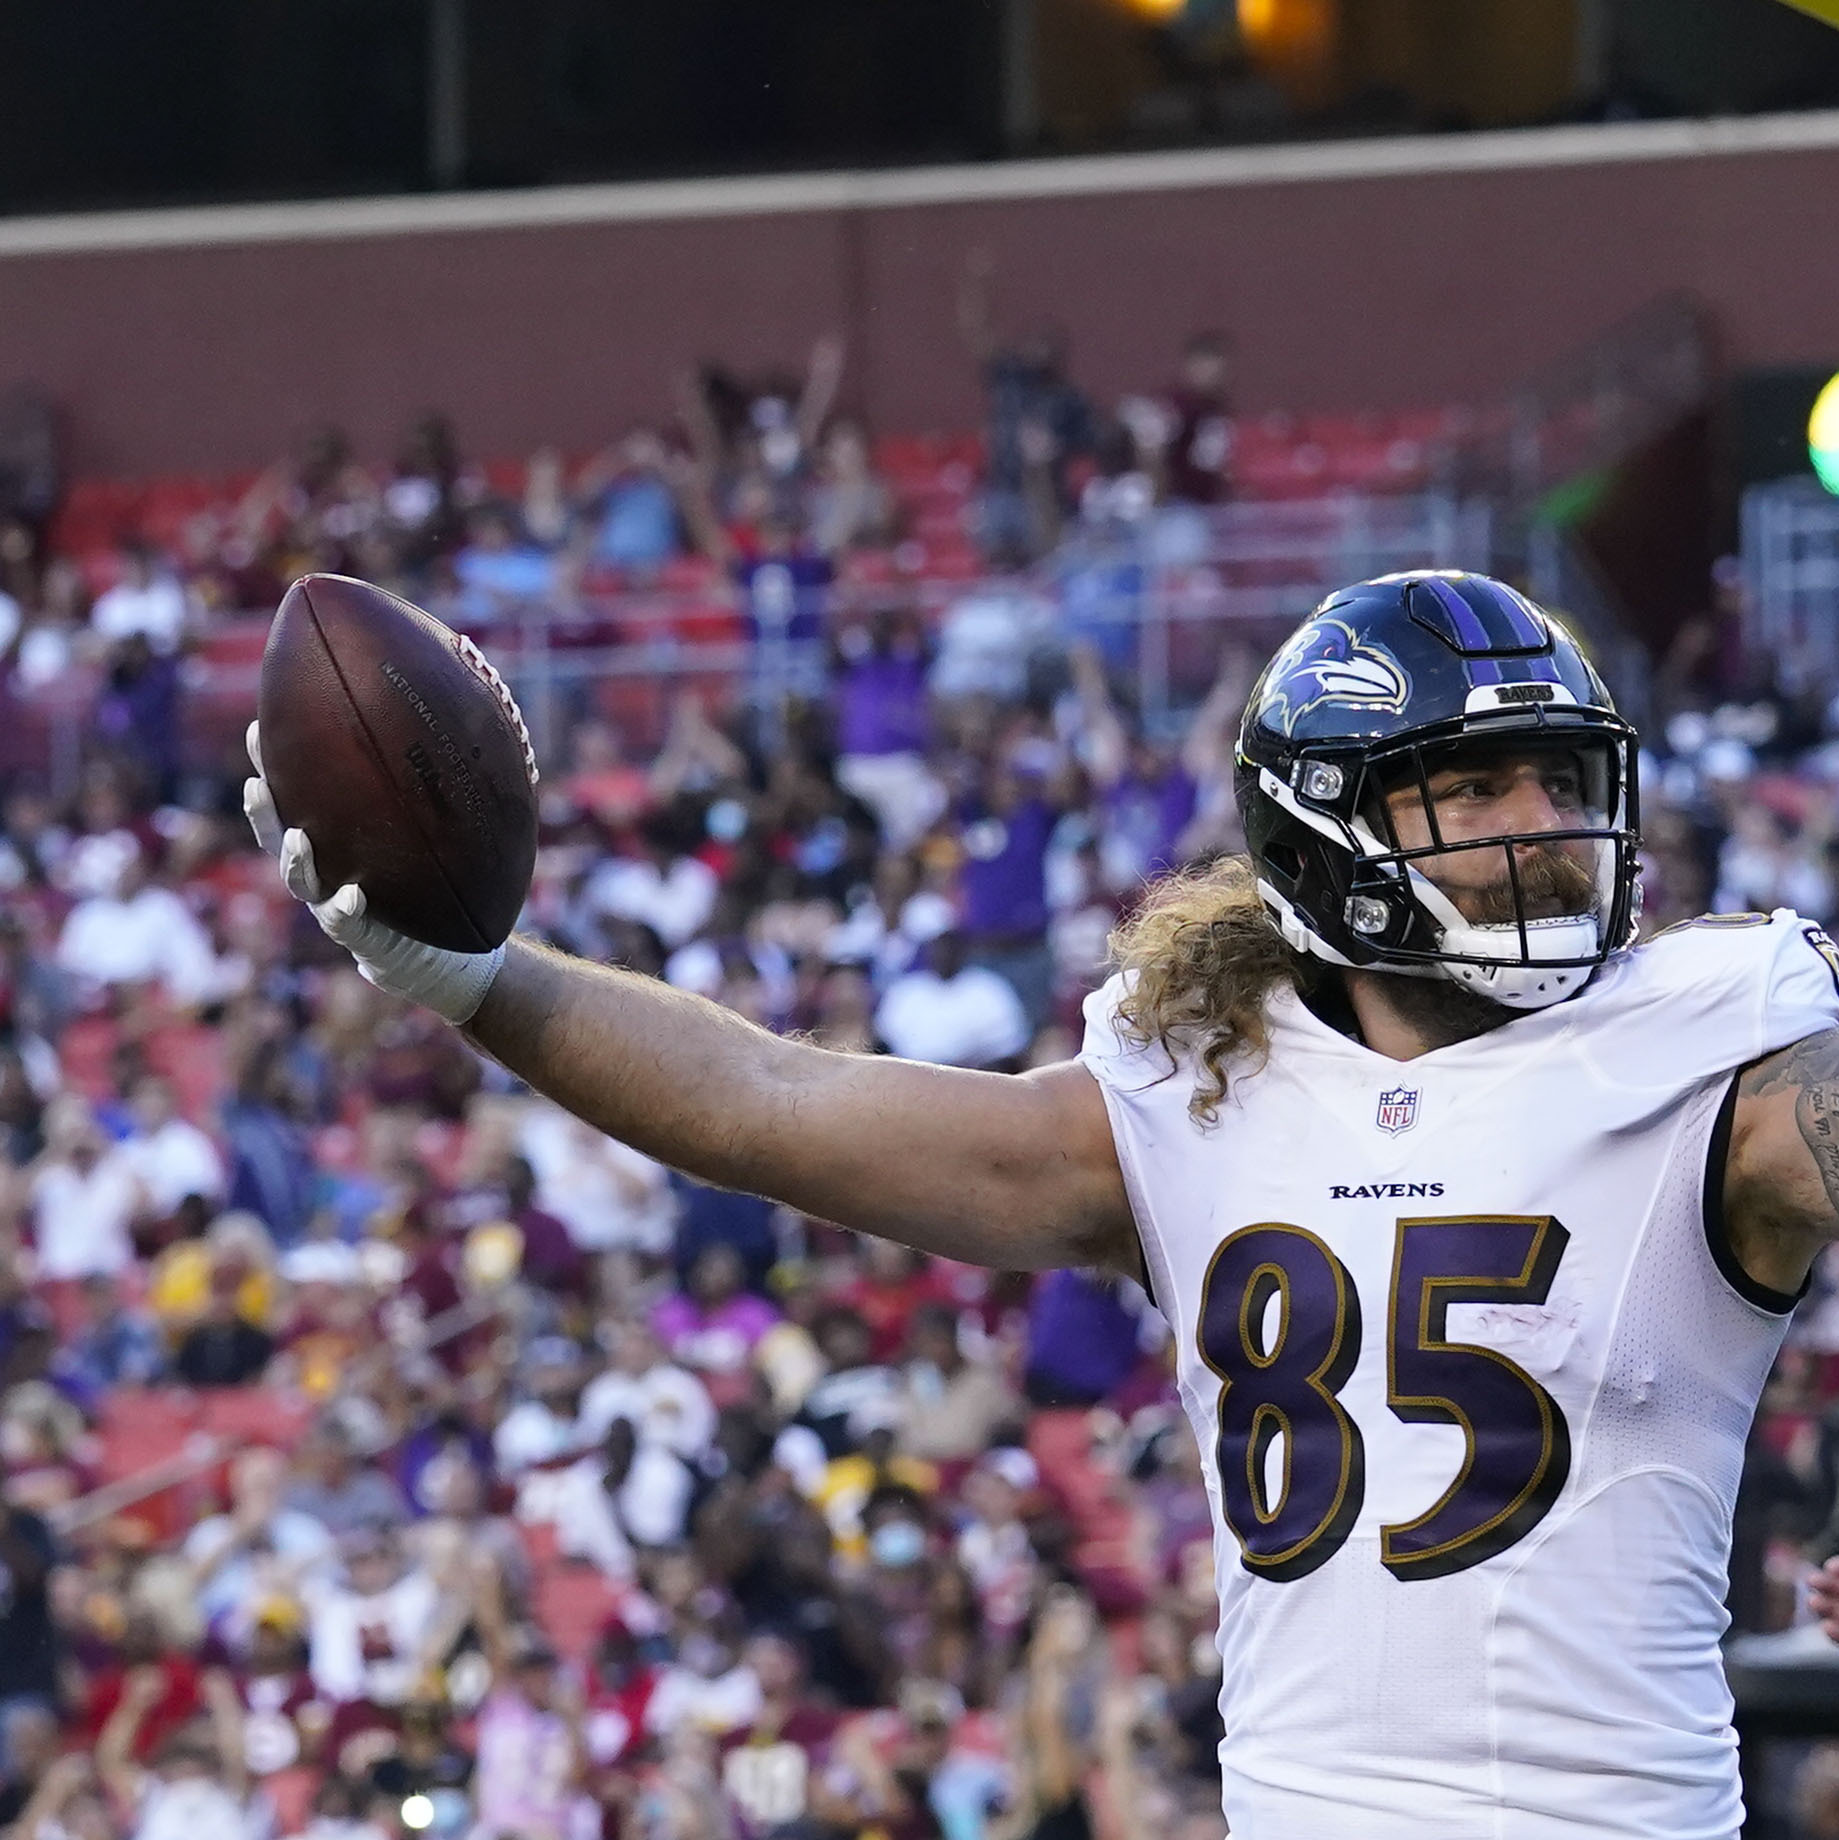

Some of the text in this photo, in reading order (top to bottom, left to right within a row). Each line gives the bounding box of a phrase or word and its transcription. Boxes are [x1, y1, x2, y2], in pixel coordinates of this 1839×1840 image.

[380, 660, 439, 732] NATIONAL
[1380, 1105, 1411, 1127] NFL
[1814, 1117, 1831, 1136] us
[1328, 1182, 1446, 1200] RAVENS
[1196, 1214, 1572, 1583] 85
